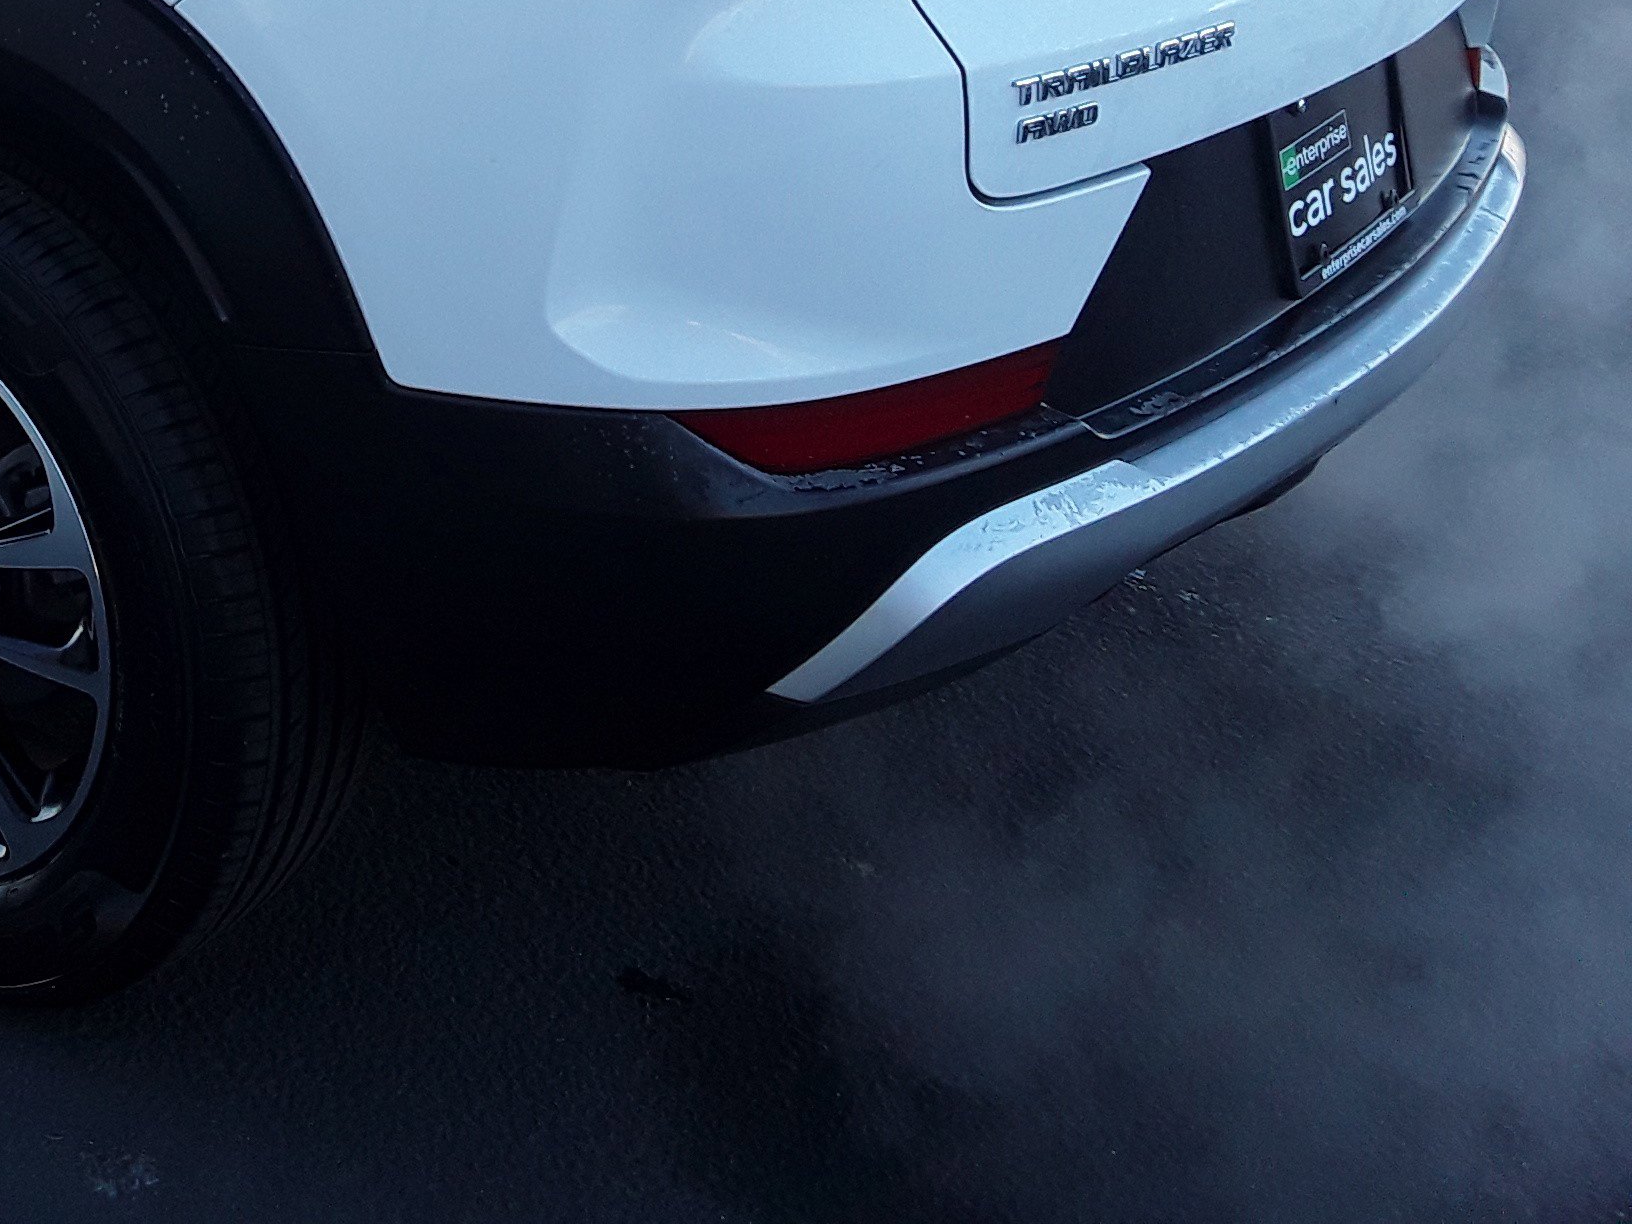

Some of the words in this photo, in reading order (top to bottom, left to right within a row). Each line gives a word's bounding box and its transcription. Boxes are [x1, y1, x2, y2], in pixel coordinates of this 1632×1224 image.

[1011, 21, 1236, 105] TRAILBLAZER
[1016, 101, 1099, 144] AWD
[1284, 122, 1347, 174] enterprise
[1288, 177, 1335, 237] car
[1341, 132, 1397, 203] sales
[1321, 206, 1407, 280] enterprisecarsales.com
